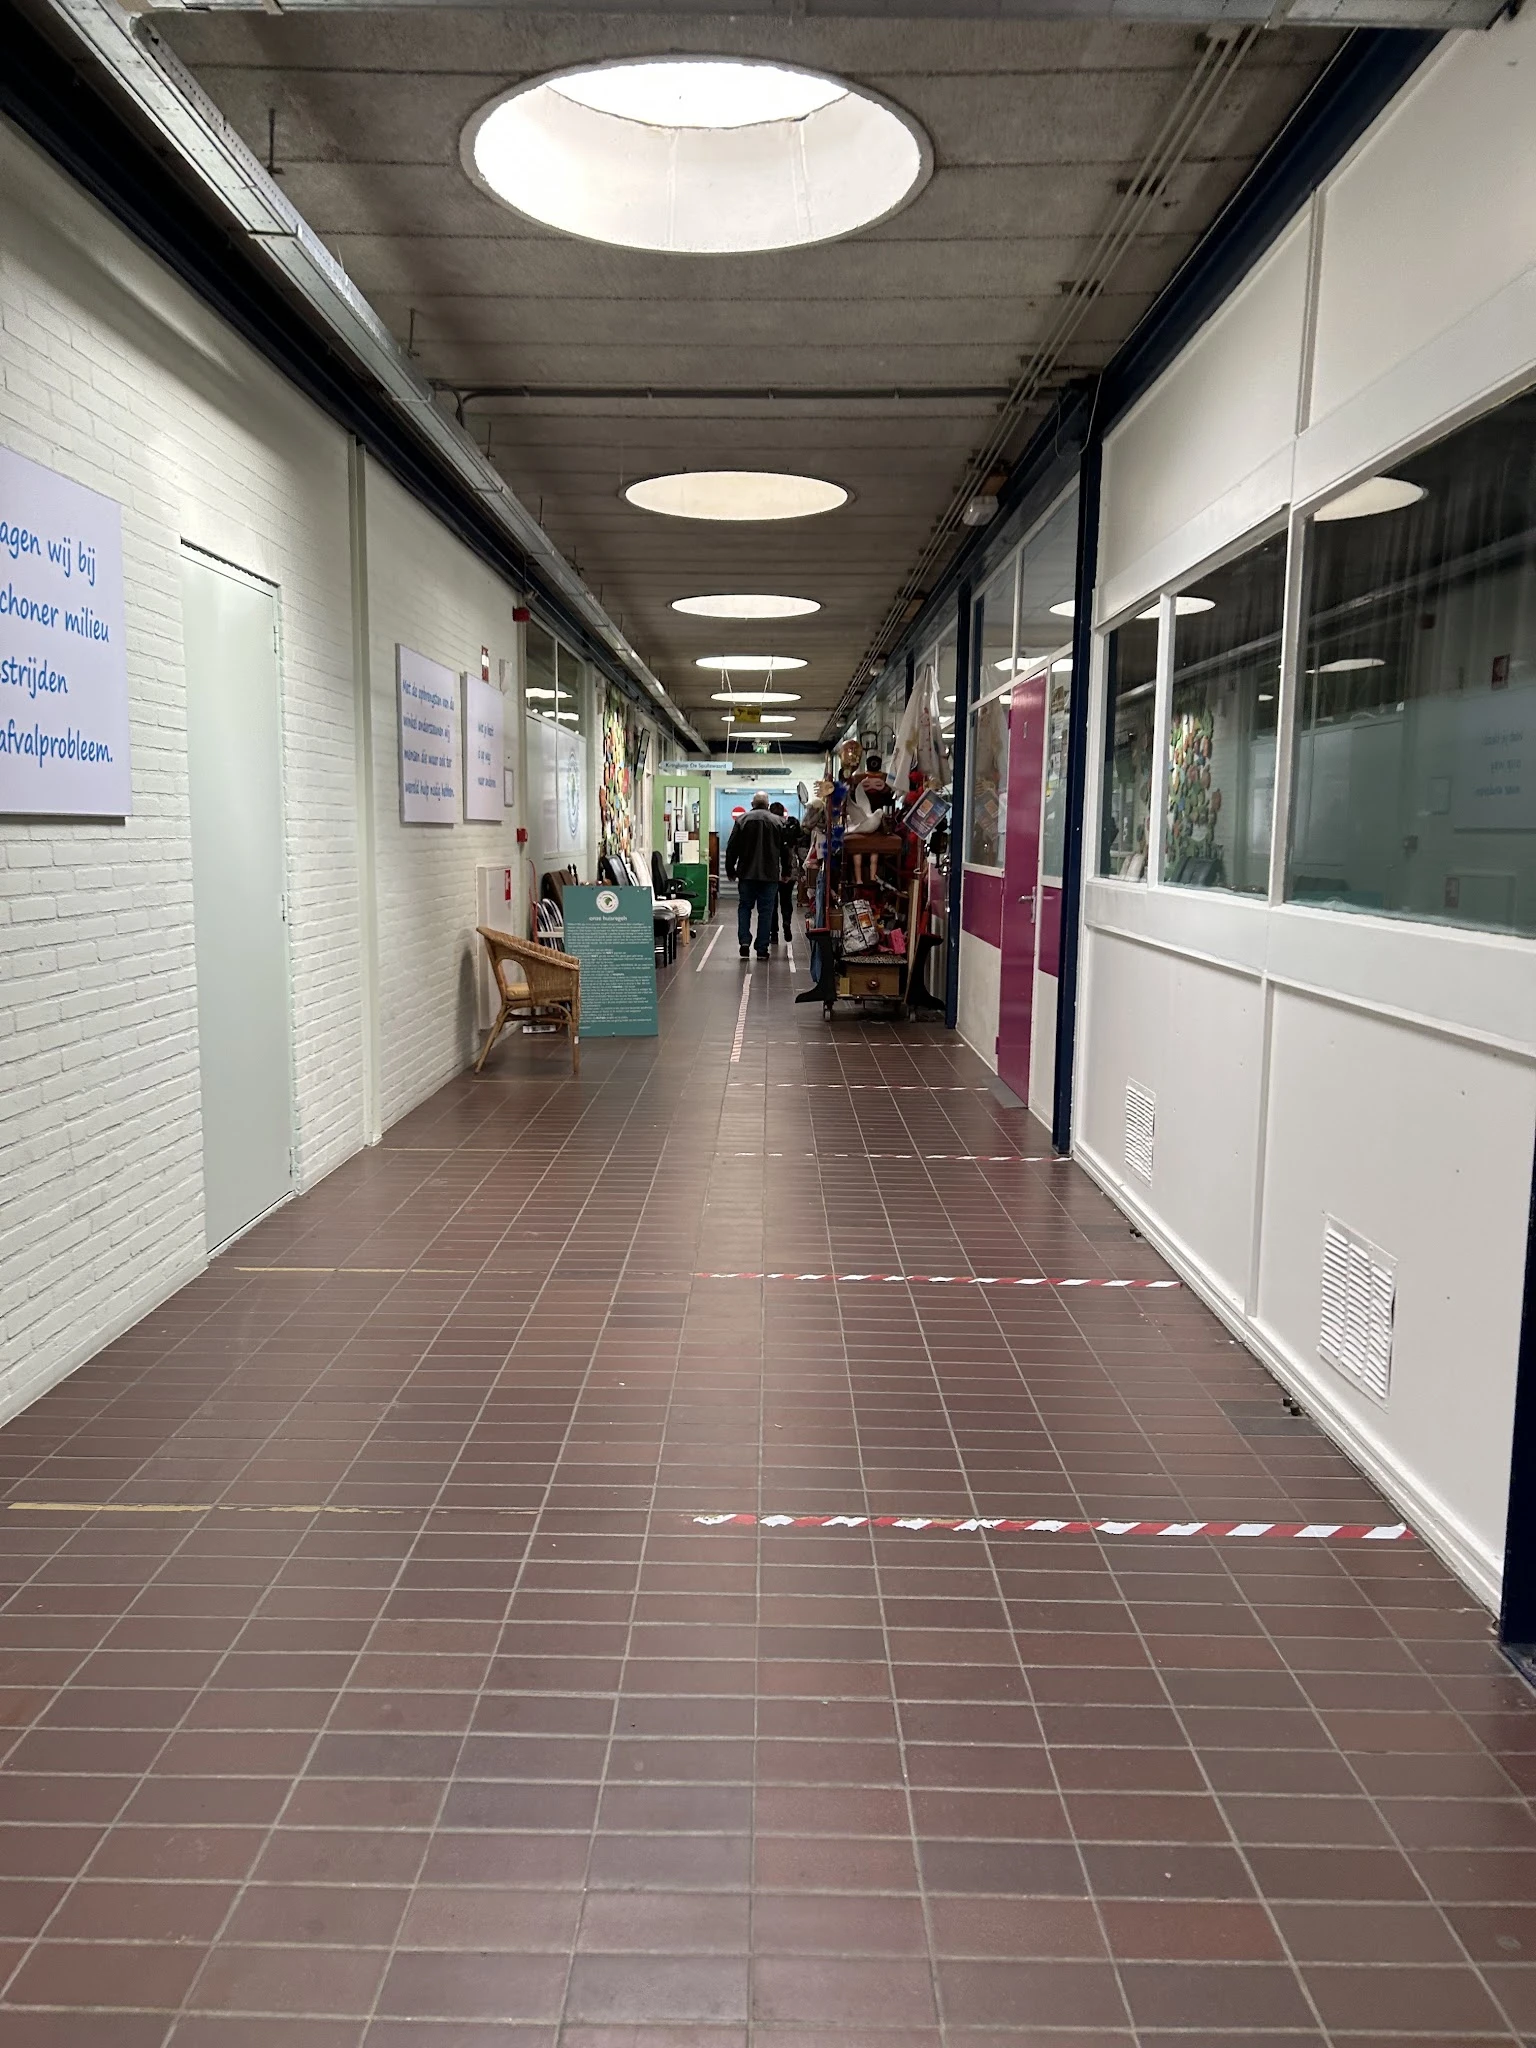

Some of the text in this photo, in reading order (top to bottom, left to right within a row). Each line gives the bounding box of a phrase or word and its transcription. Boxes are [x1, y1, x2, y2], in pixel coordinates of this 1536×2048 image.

[0, 521, 96, 586] agen wij bij
[0, 583, 109, 643] choner milieu
[0, 655, 68, 699] strijden
